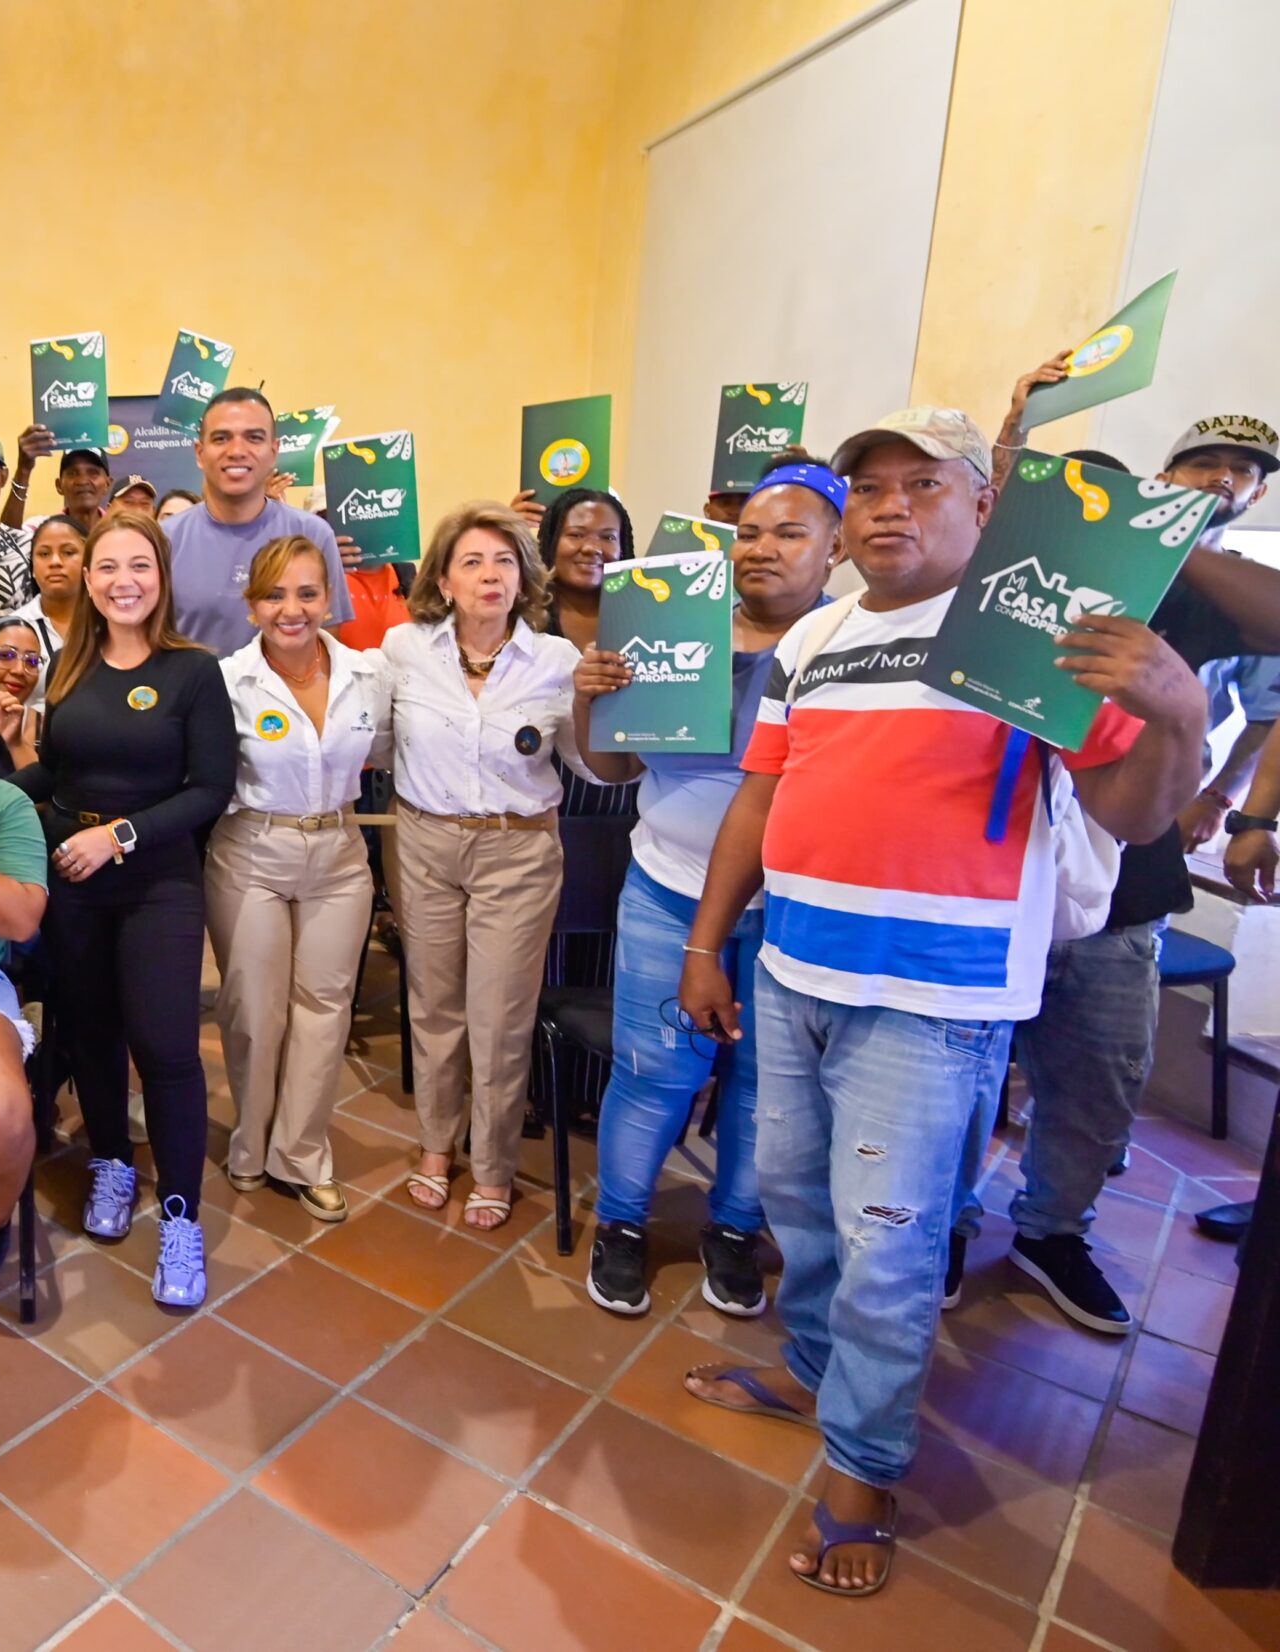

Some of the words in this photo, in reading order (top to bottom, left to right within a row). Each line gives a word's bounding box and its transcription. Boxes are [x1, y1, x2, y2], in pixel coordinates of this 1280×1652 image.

[178, 382, 198, 396] CASA
[50, 394, 78, 405] CASA
[1195, 415, 1279, 444] BATMAN
[134, 440, 180, 450] Cartagena
[180, 438, 192, 447] de
[736, 439, 766, 449] CASA
[348, 503, 381, 516] CASA
[1006, 572, 1028, 592] MI
[998, 586, 1058, 623] CASA
[625, 652, 639, 662] MI
[639, 673, 700, 683] PROPIEDAD
